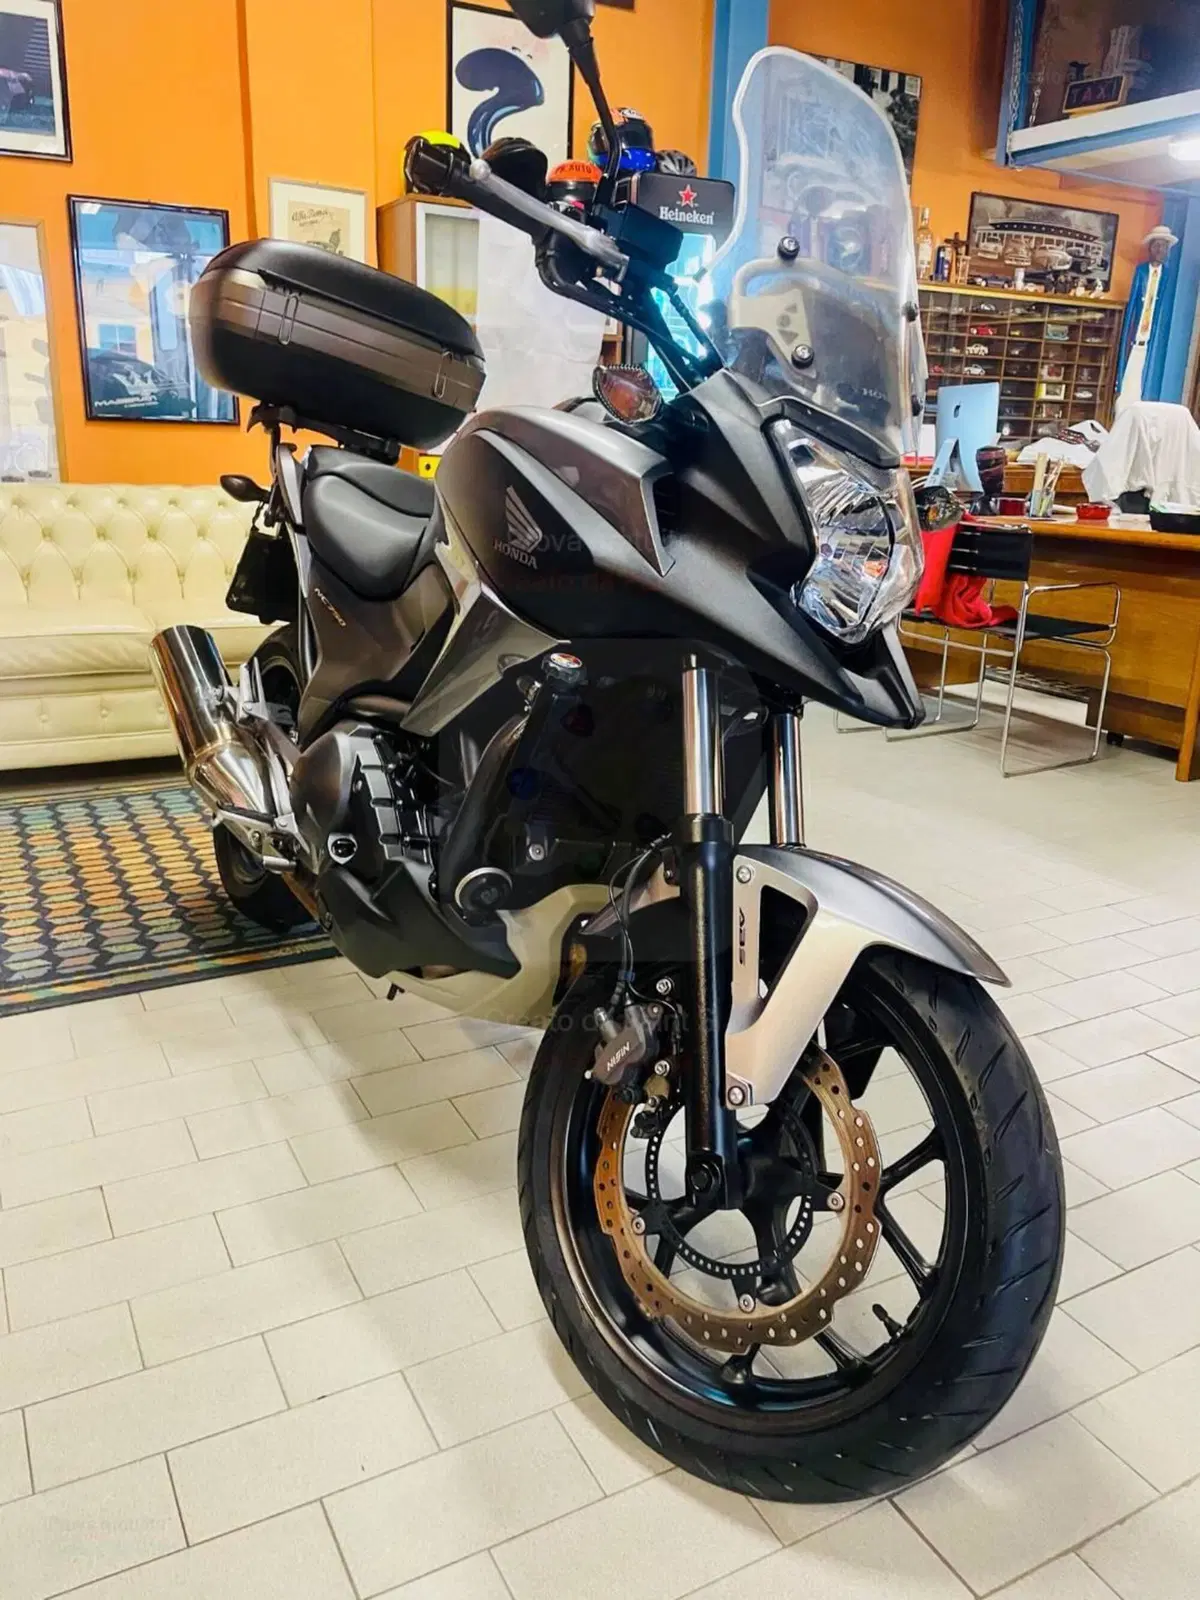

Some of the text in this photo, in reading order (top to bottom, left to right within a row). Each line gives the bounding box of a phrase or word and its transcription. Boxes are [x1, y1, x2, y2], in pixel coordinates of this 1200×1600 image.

[1070, 78, 1118, 104] TAXI
[659, 206, 715, 225] Heineken
[493, 538, 538, 570] HONDA
